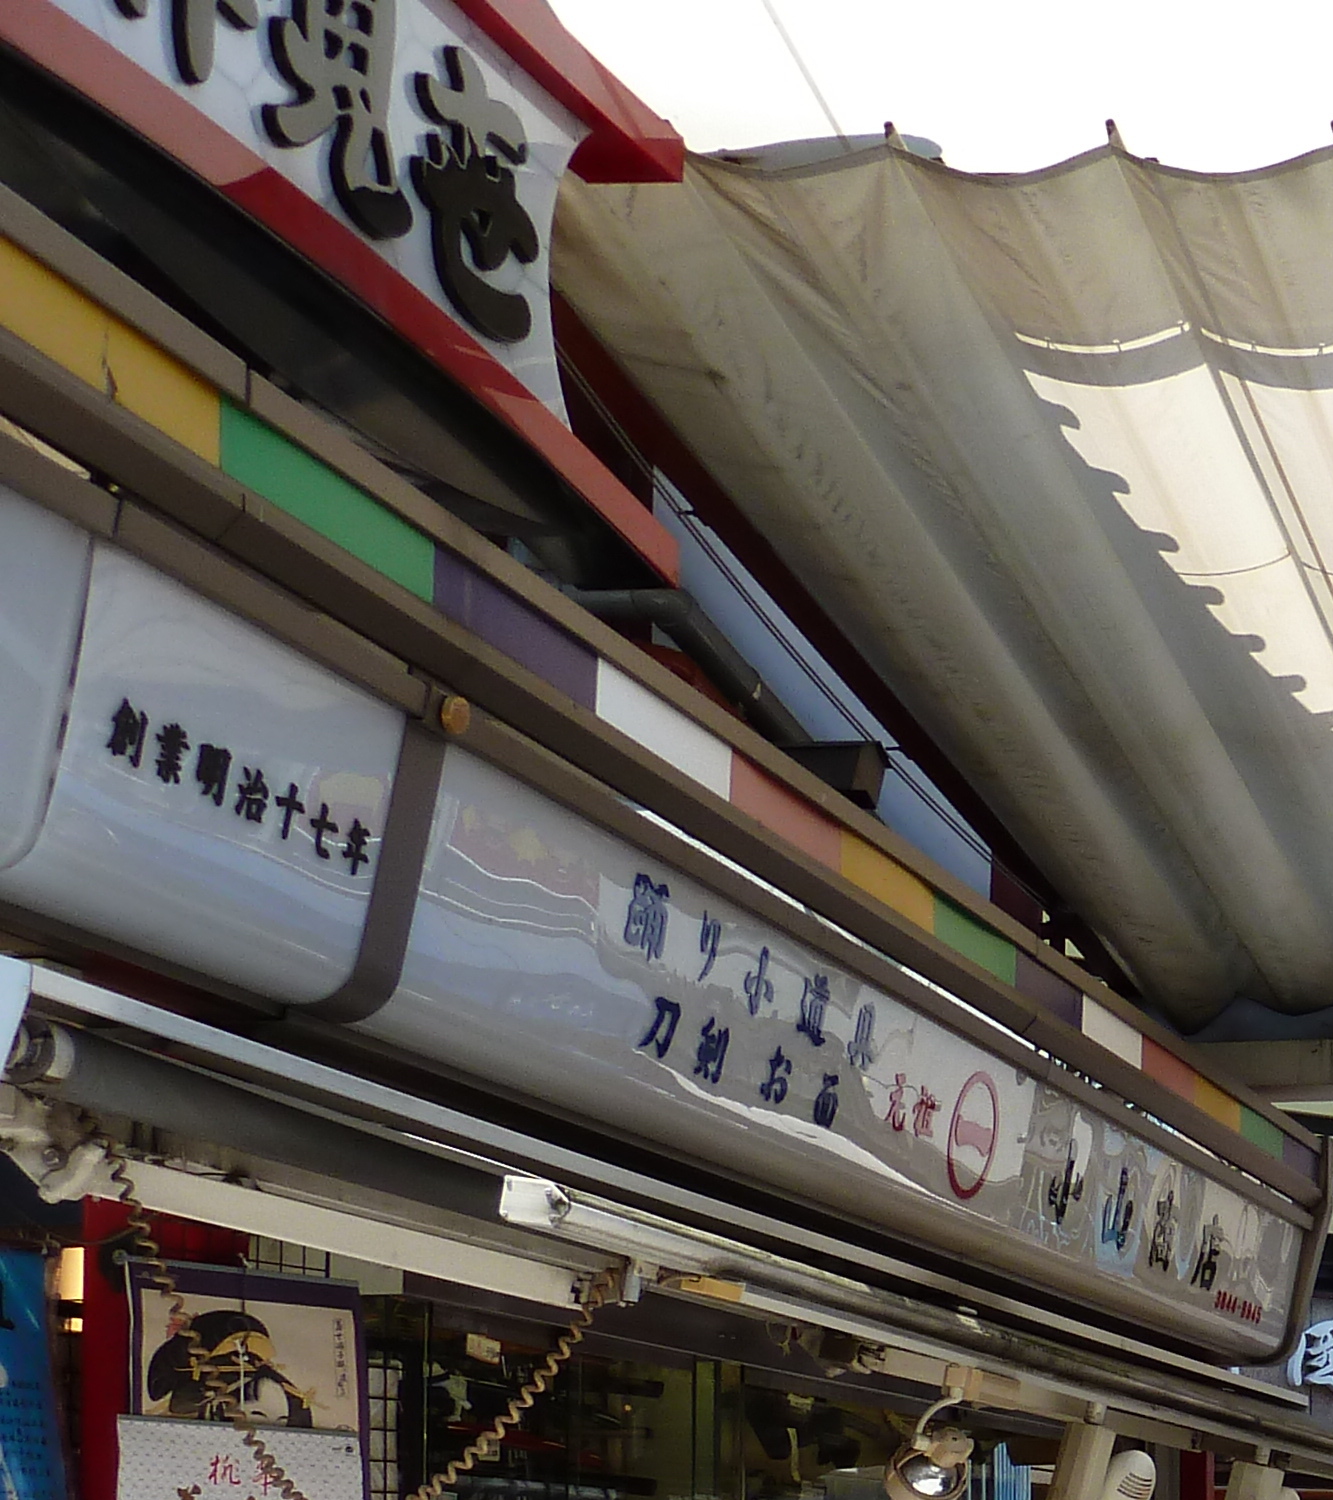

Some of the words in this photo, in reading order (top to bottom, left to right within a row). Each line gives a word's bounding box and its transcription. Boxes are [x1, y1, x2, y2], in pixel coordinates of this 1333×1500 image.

[106, 698, 371, 875] 創業明治十七年
